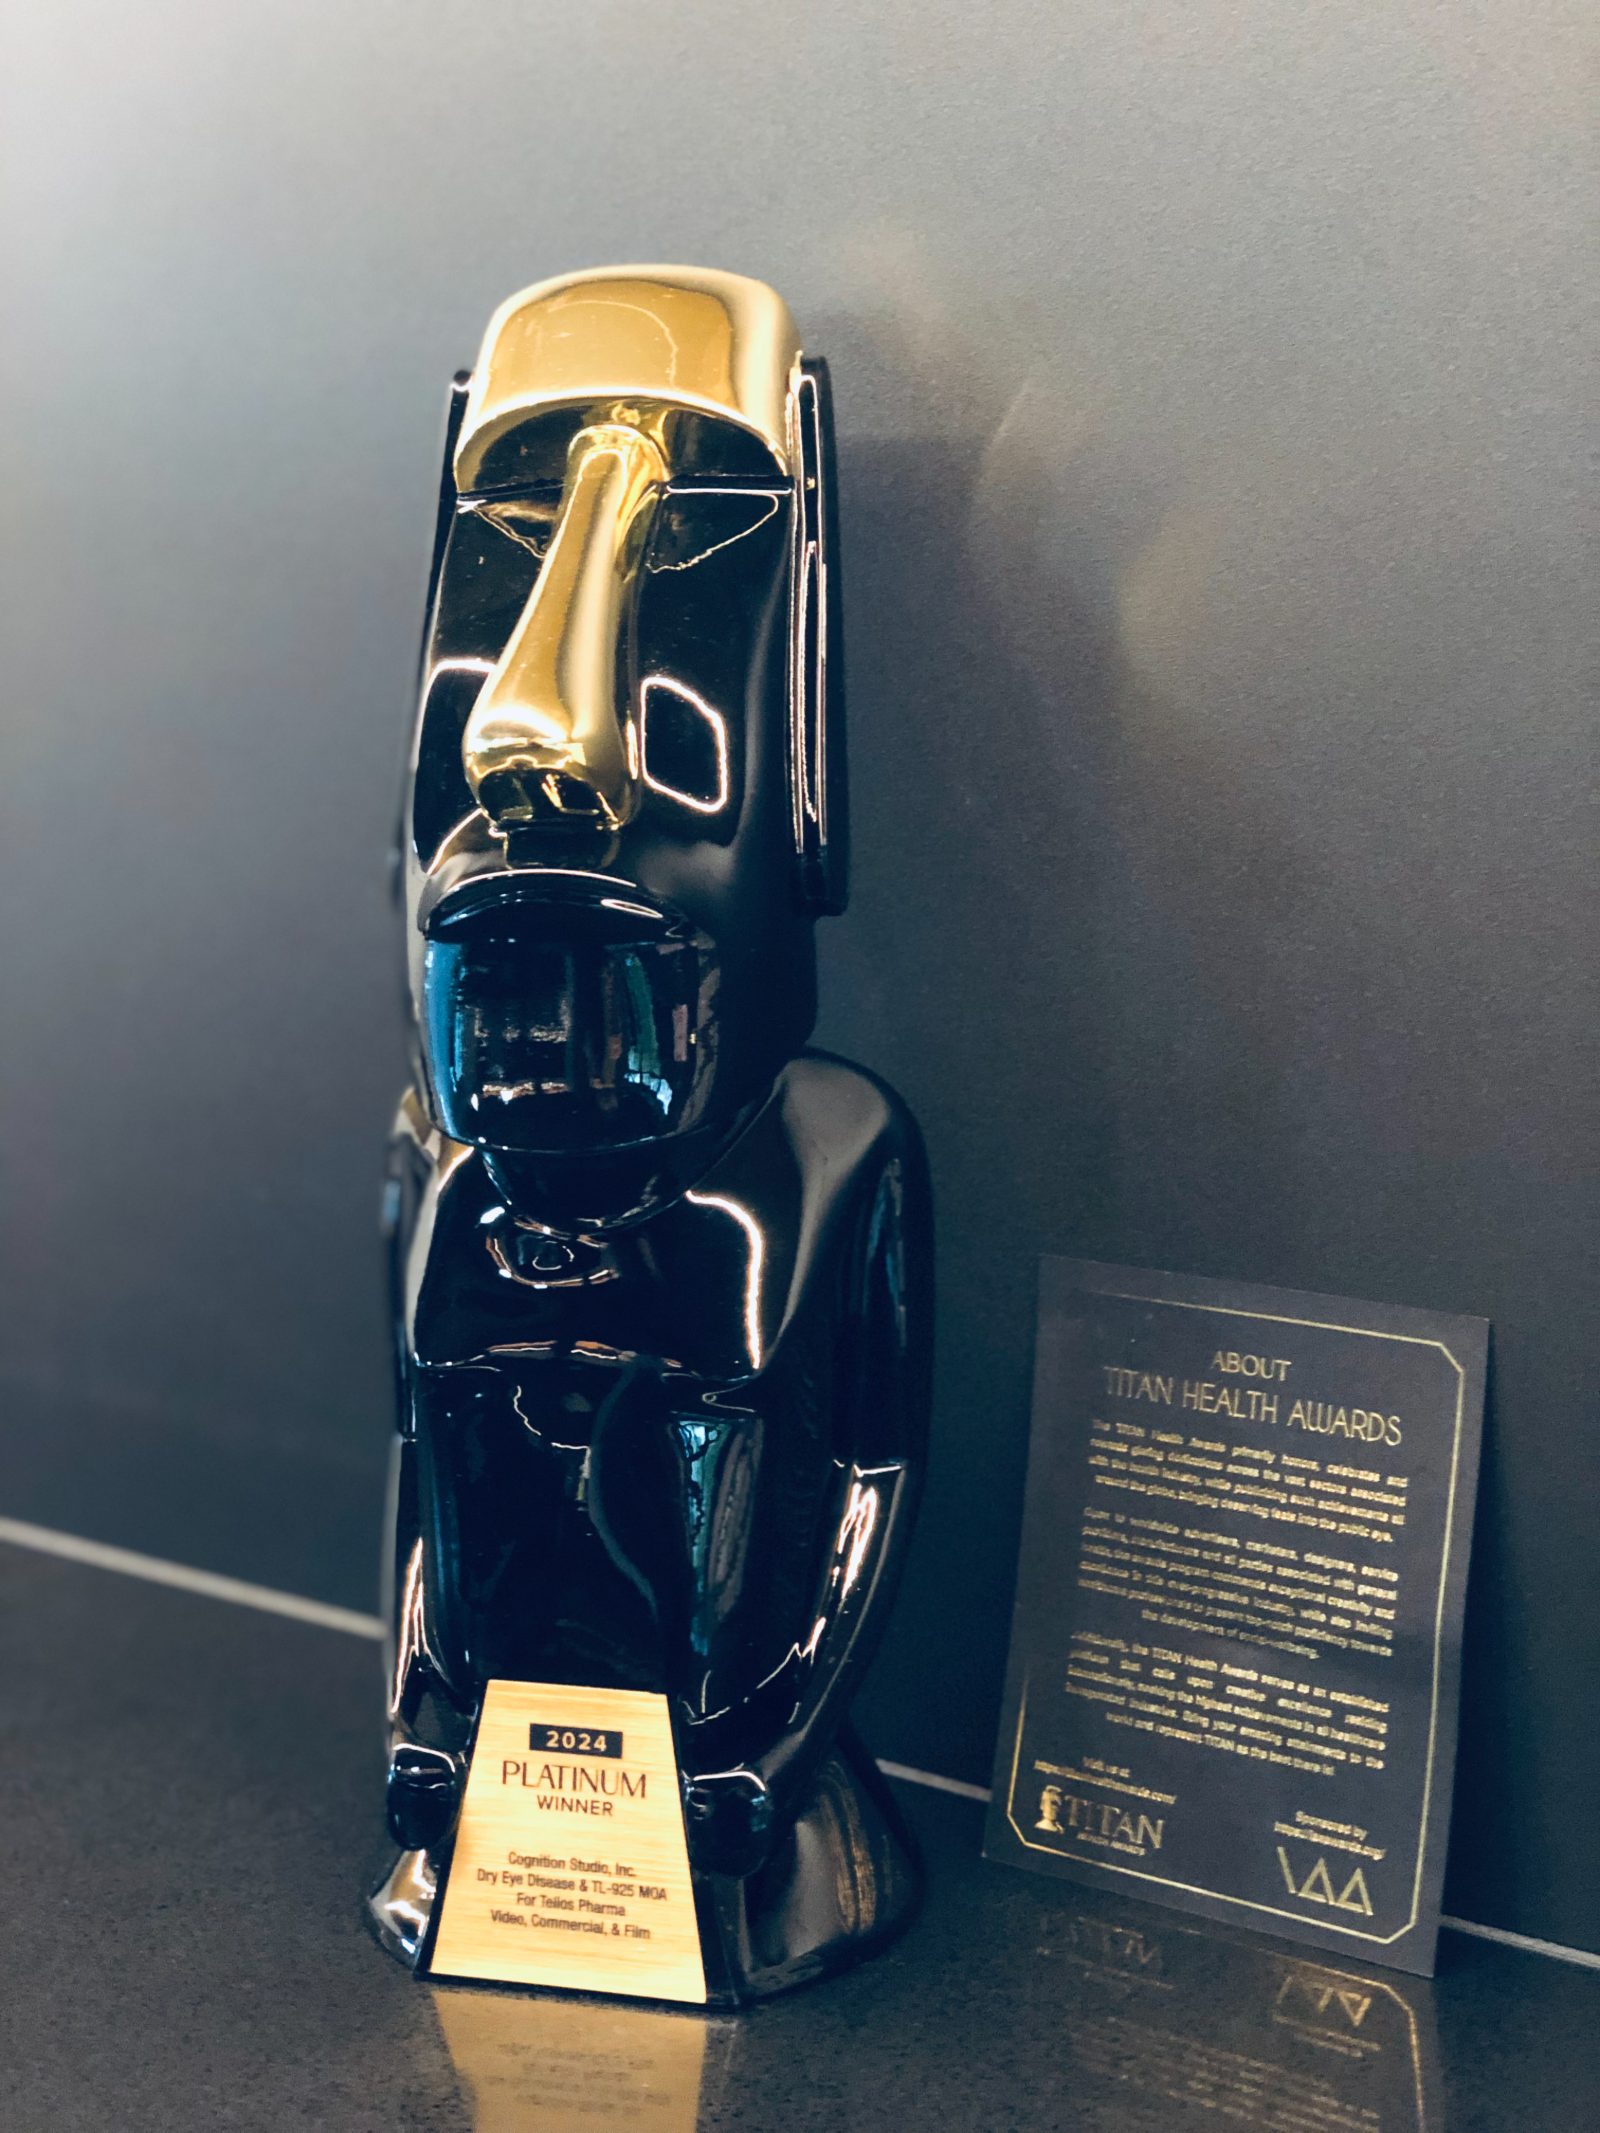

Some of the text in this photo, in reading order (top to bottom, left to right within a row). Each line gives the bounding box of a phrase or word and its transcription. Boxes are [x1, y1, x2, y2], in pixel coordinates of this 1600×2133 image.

[1211, 1350, 1293, 1382] ABOUT
[1103, 1366, 1403, 1447] TITAN HEALTH AWARDS
[546, 1731, 607, 1752] 2024
[502, 1760, 647, 1799] PLATINUM
[537, 1795, 613, 1817] WINNER
[1064, 1795, 1166, 1849] TITAN
[508, 1851, 637, 1878] Cognition Studio, Inc.
[477, 1868, 668, 1901] Dry Eye Disease & TL-925 MOA
[516, 1892, 537, 1905] For
[579, 1899, 626, 1917] Pharma
[491, 1909, 651, 1940] Video, Commercial, & Film
